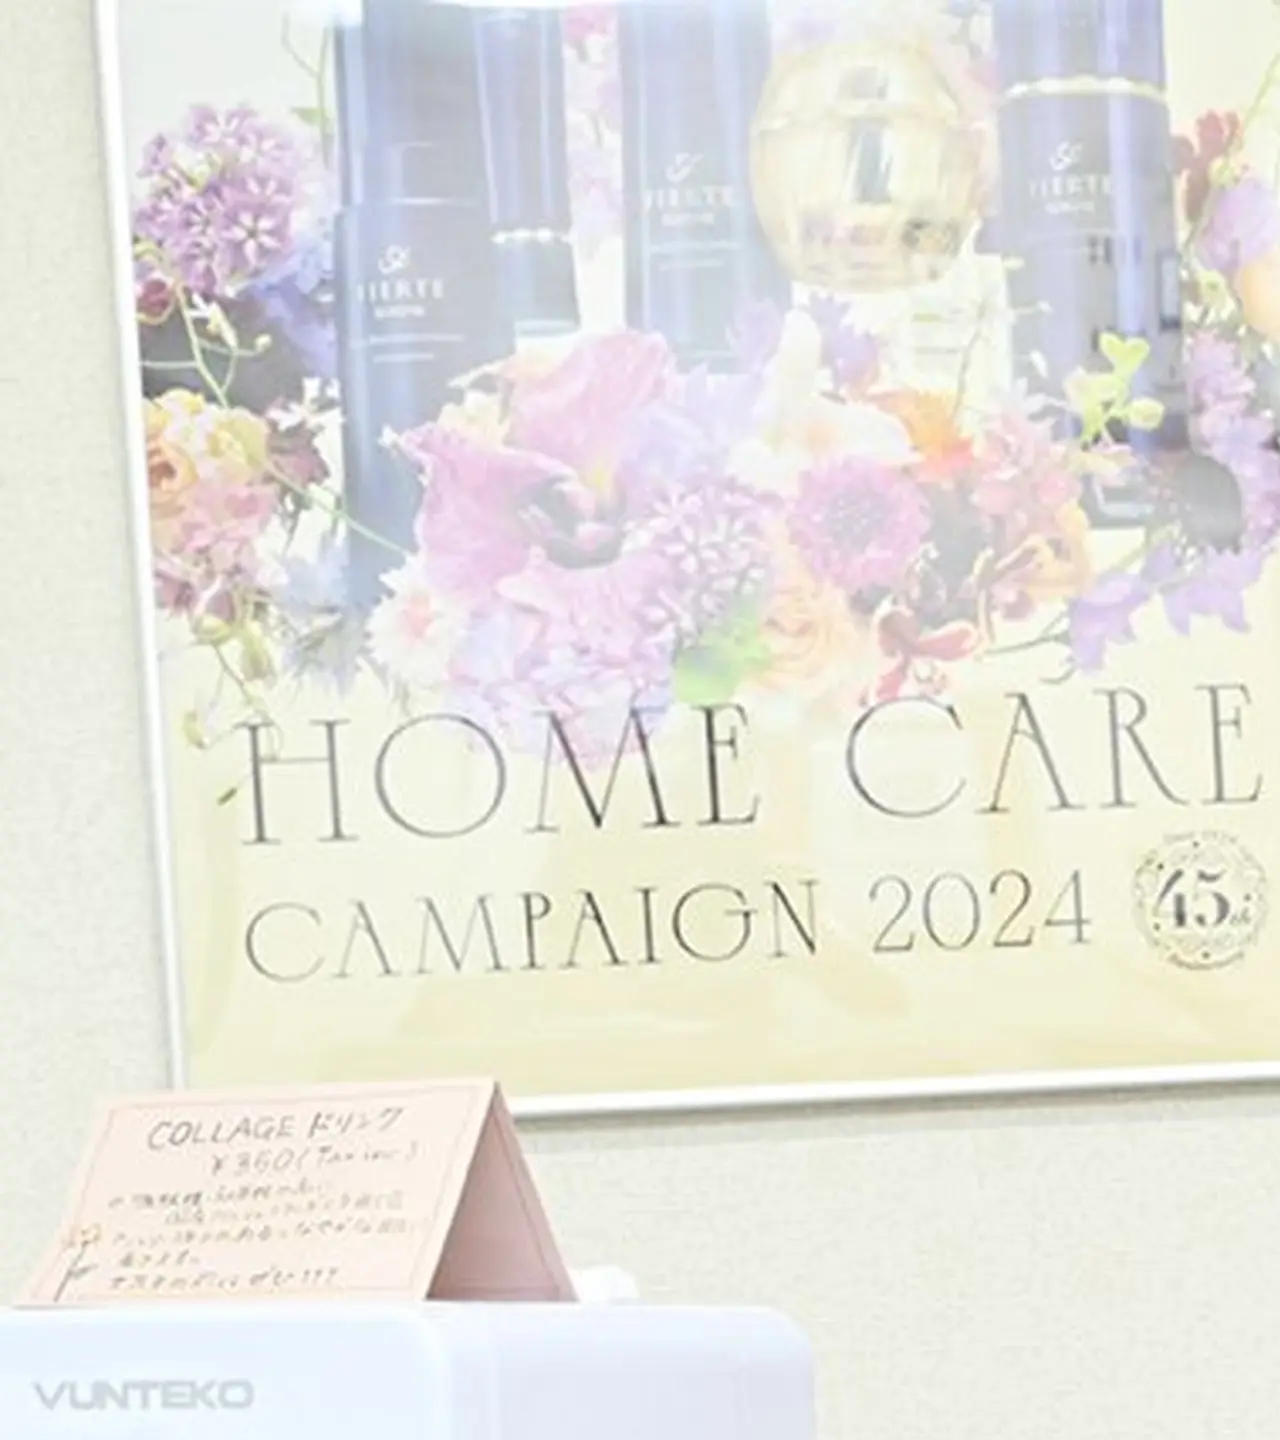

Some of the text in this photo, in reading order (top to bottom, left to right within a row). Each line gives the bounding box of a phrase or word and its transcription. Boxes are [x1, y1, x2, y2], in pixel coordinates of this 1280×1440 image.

[234, 682, 1264, 845] HOME CARE
[244, 879, 820, 984] CAMPAIGN
[868, 869, 1092, 955] 2024
[147, 1114, 297, 1150] COLLAGE
